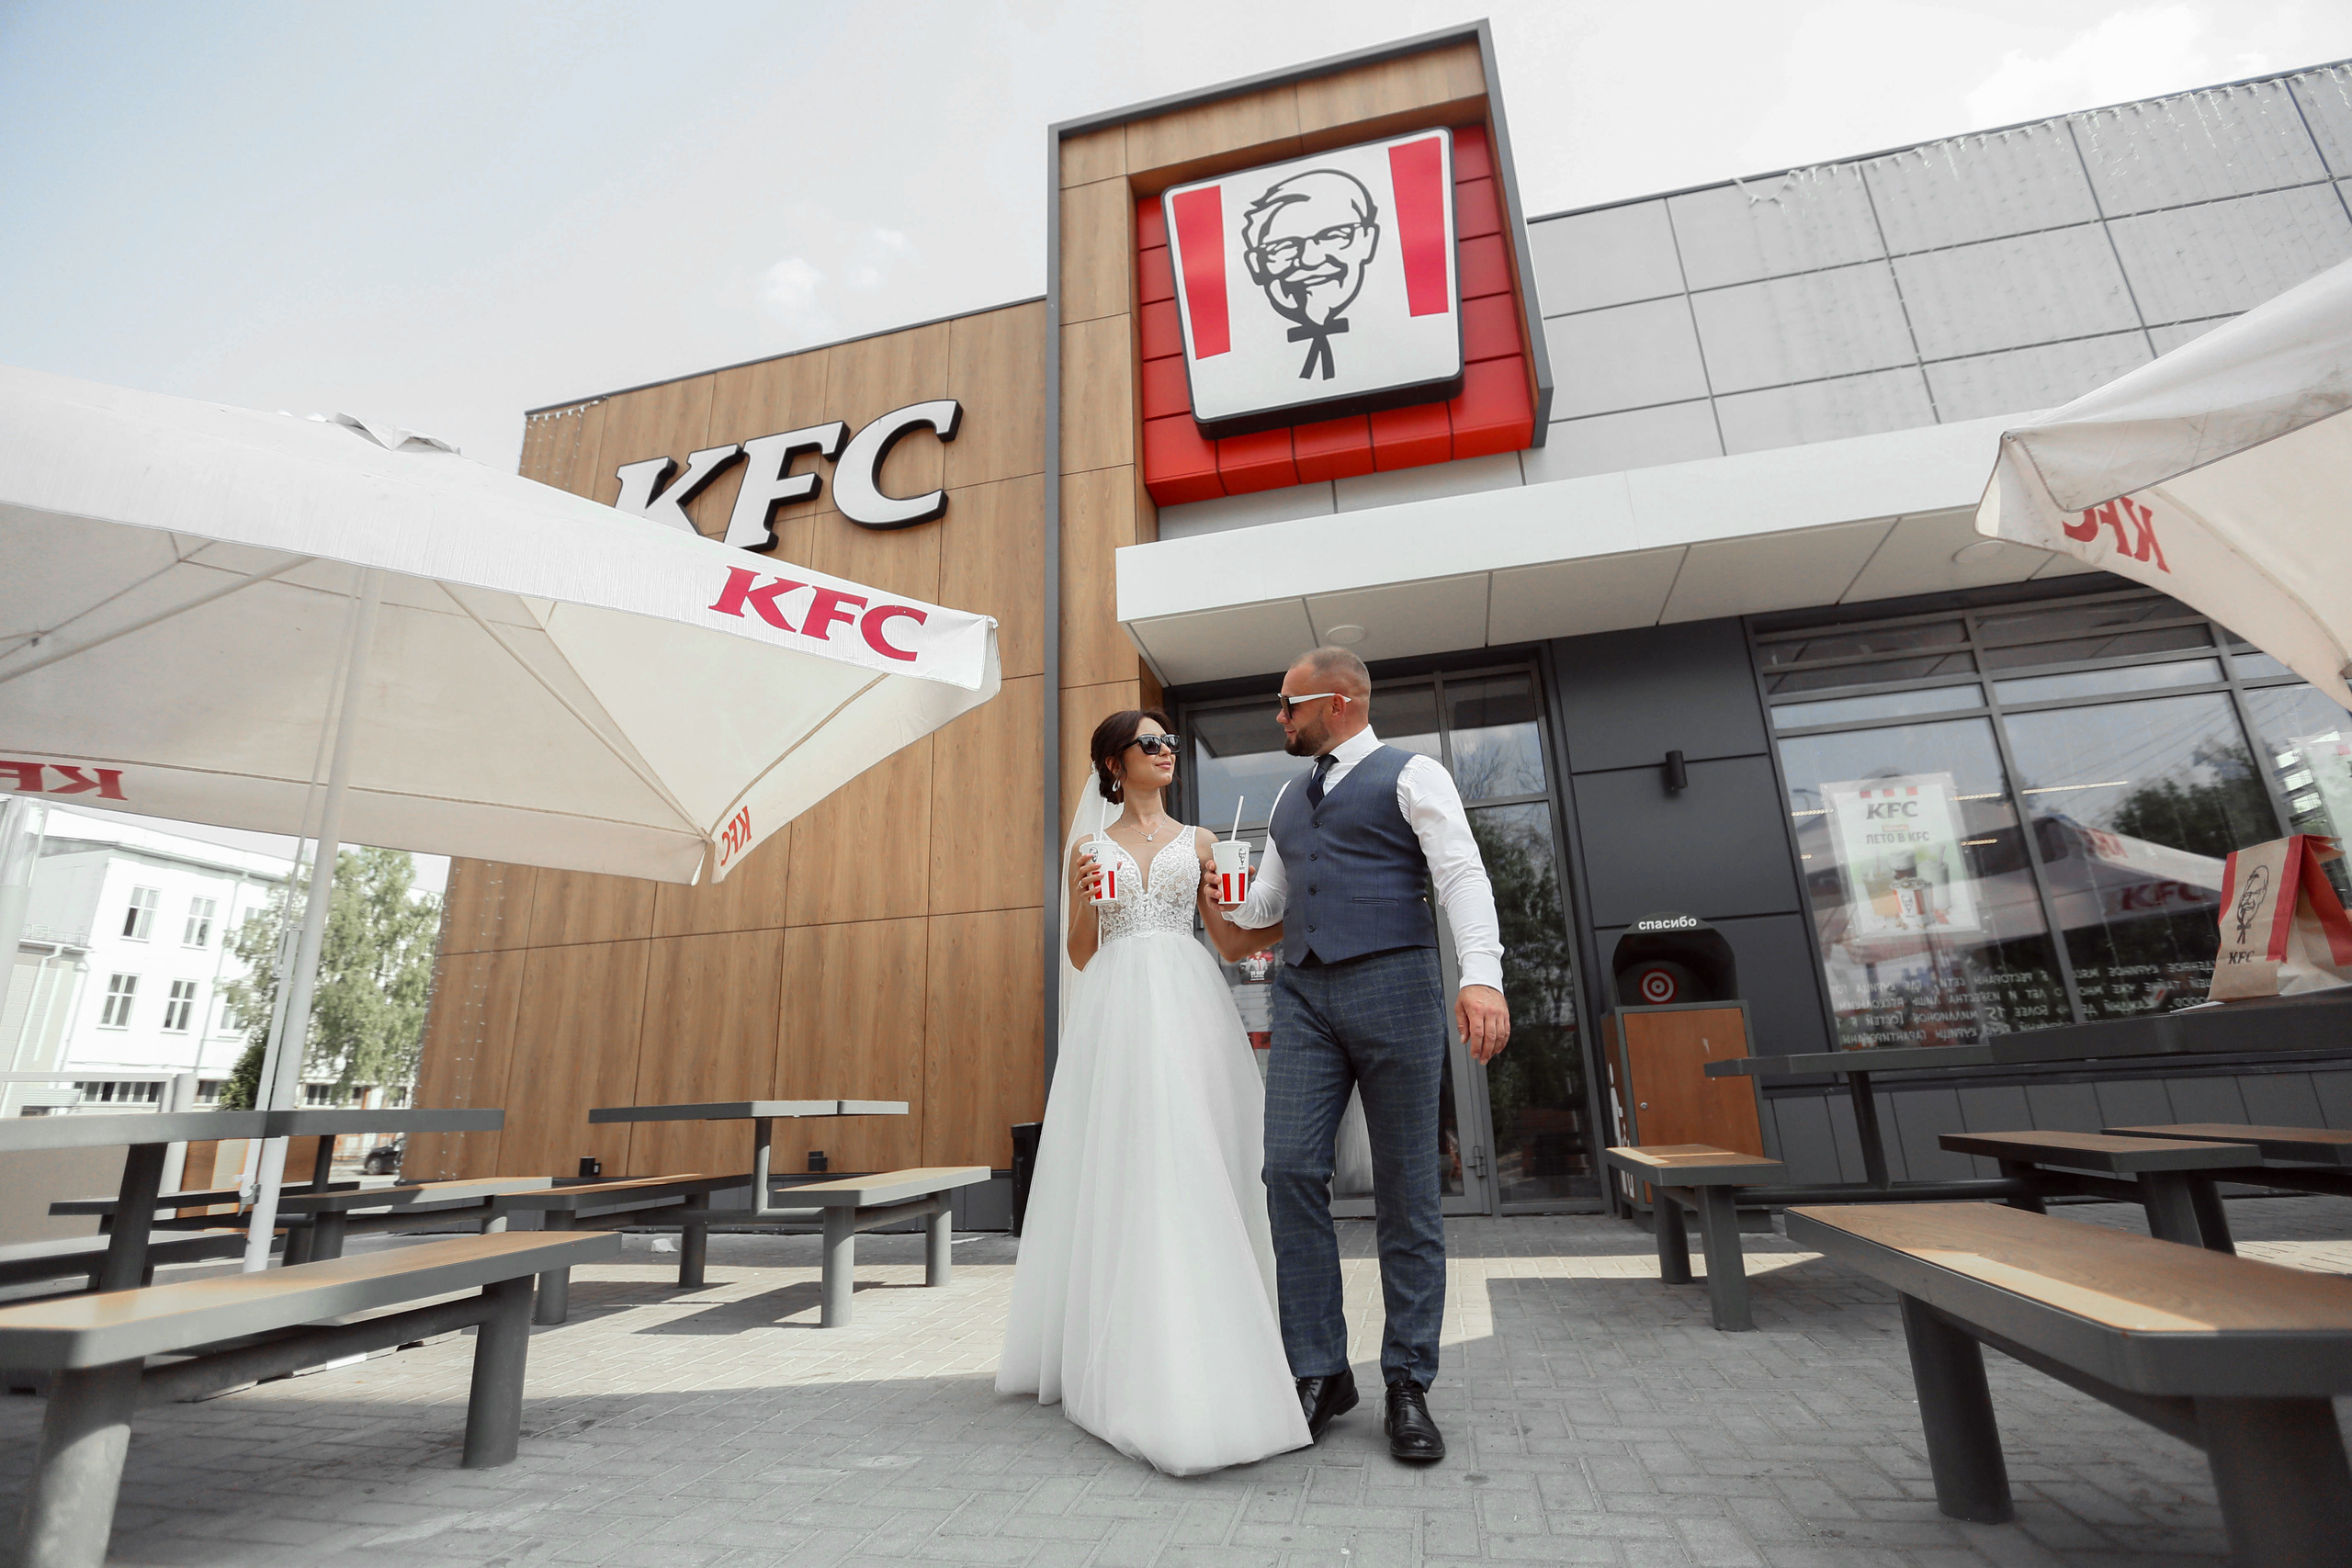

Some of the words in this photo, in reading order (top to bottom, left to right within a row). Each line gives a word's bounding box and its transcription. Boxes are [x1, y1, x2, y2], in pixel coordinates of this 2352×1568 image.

[615, 399, 964, 551] KFC
[707, 565, 928, 661] KFC
[1866, 801, 1918, 819] KFC
[1866, 832, 1894, 844] ЛЕТО
[1898, 832, 1905, 842] В
[1909, 831, 1929, 842] KFC
[1638, 916, 1697, 931] спасибо
[2228, 950, 2255, 964] KFC
